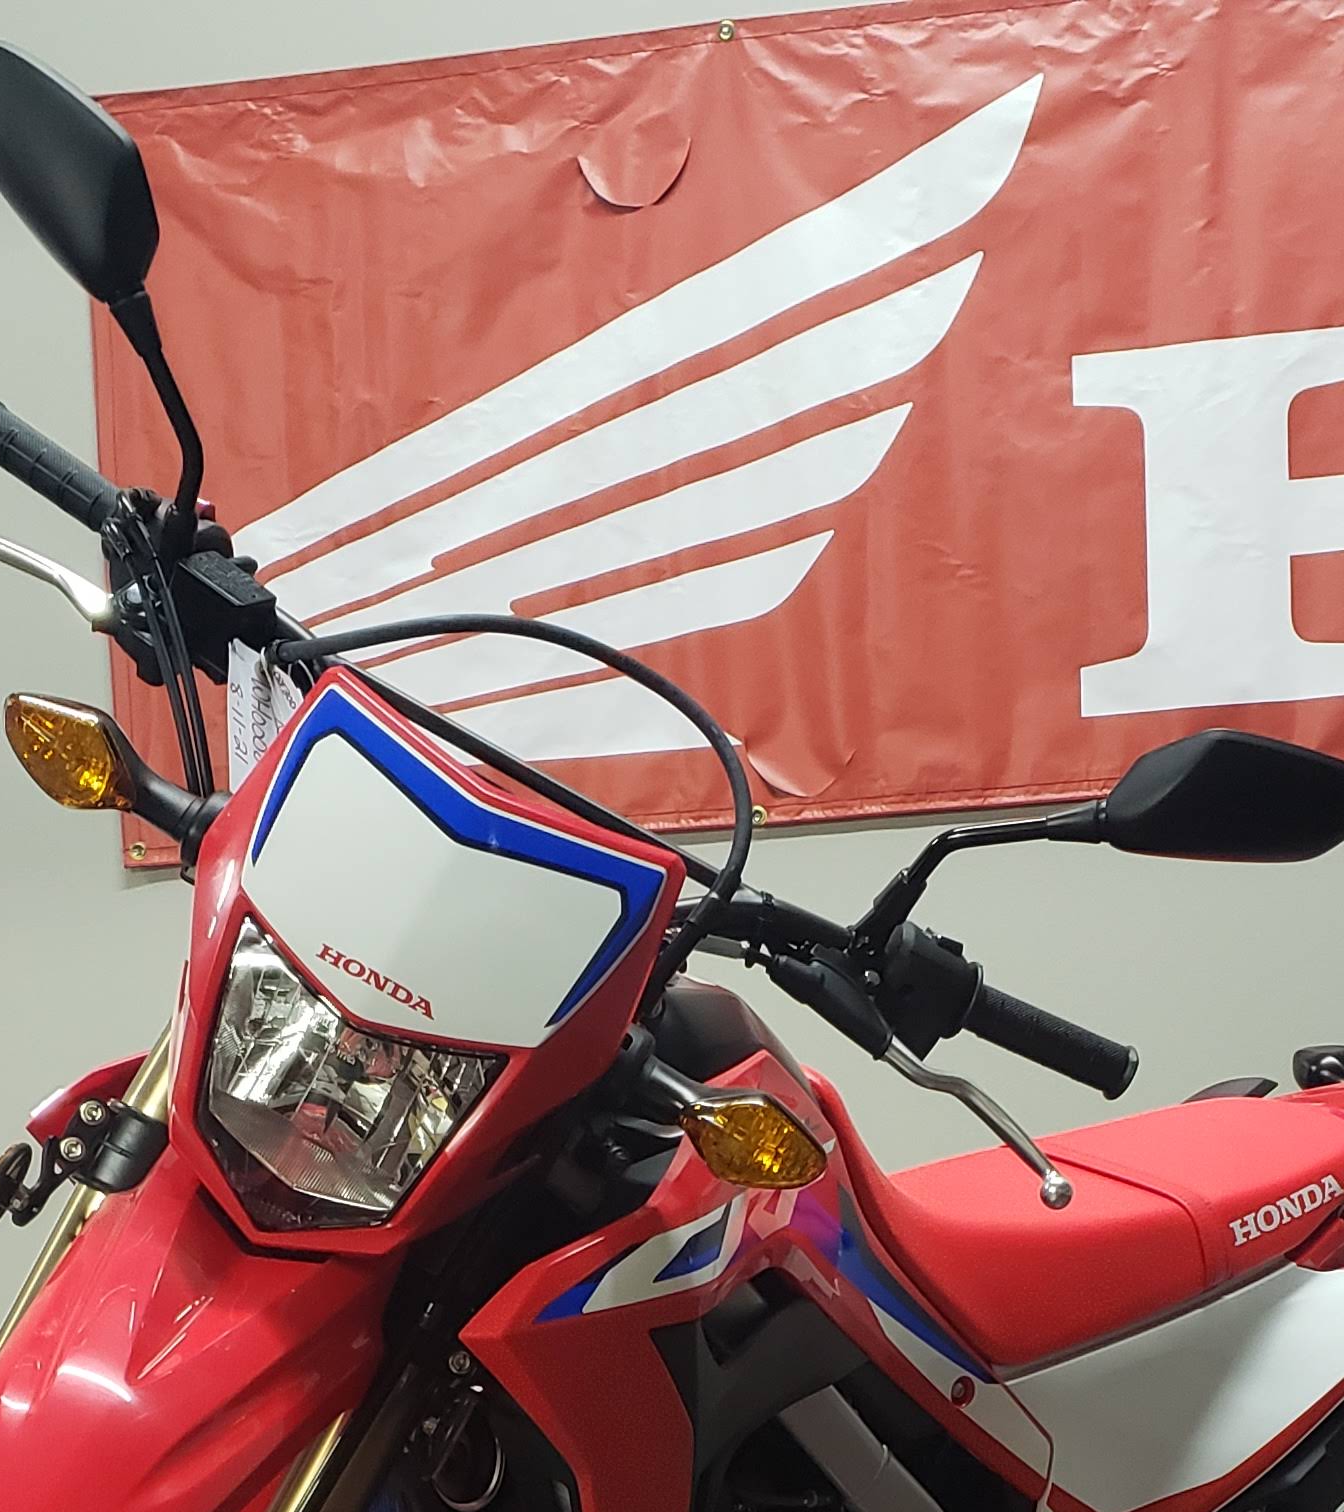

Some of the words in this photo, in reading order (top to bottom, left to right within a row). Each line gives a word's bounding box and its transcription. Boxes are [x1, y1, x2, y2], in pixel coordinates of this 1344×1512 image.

[230, 681, 249, 765] 8-11-21
[315, 943, 435, 1021] HONDA
[1228, 1174, 1344, 1247] HONDA
